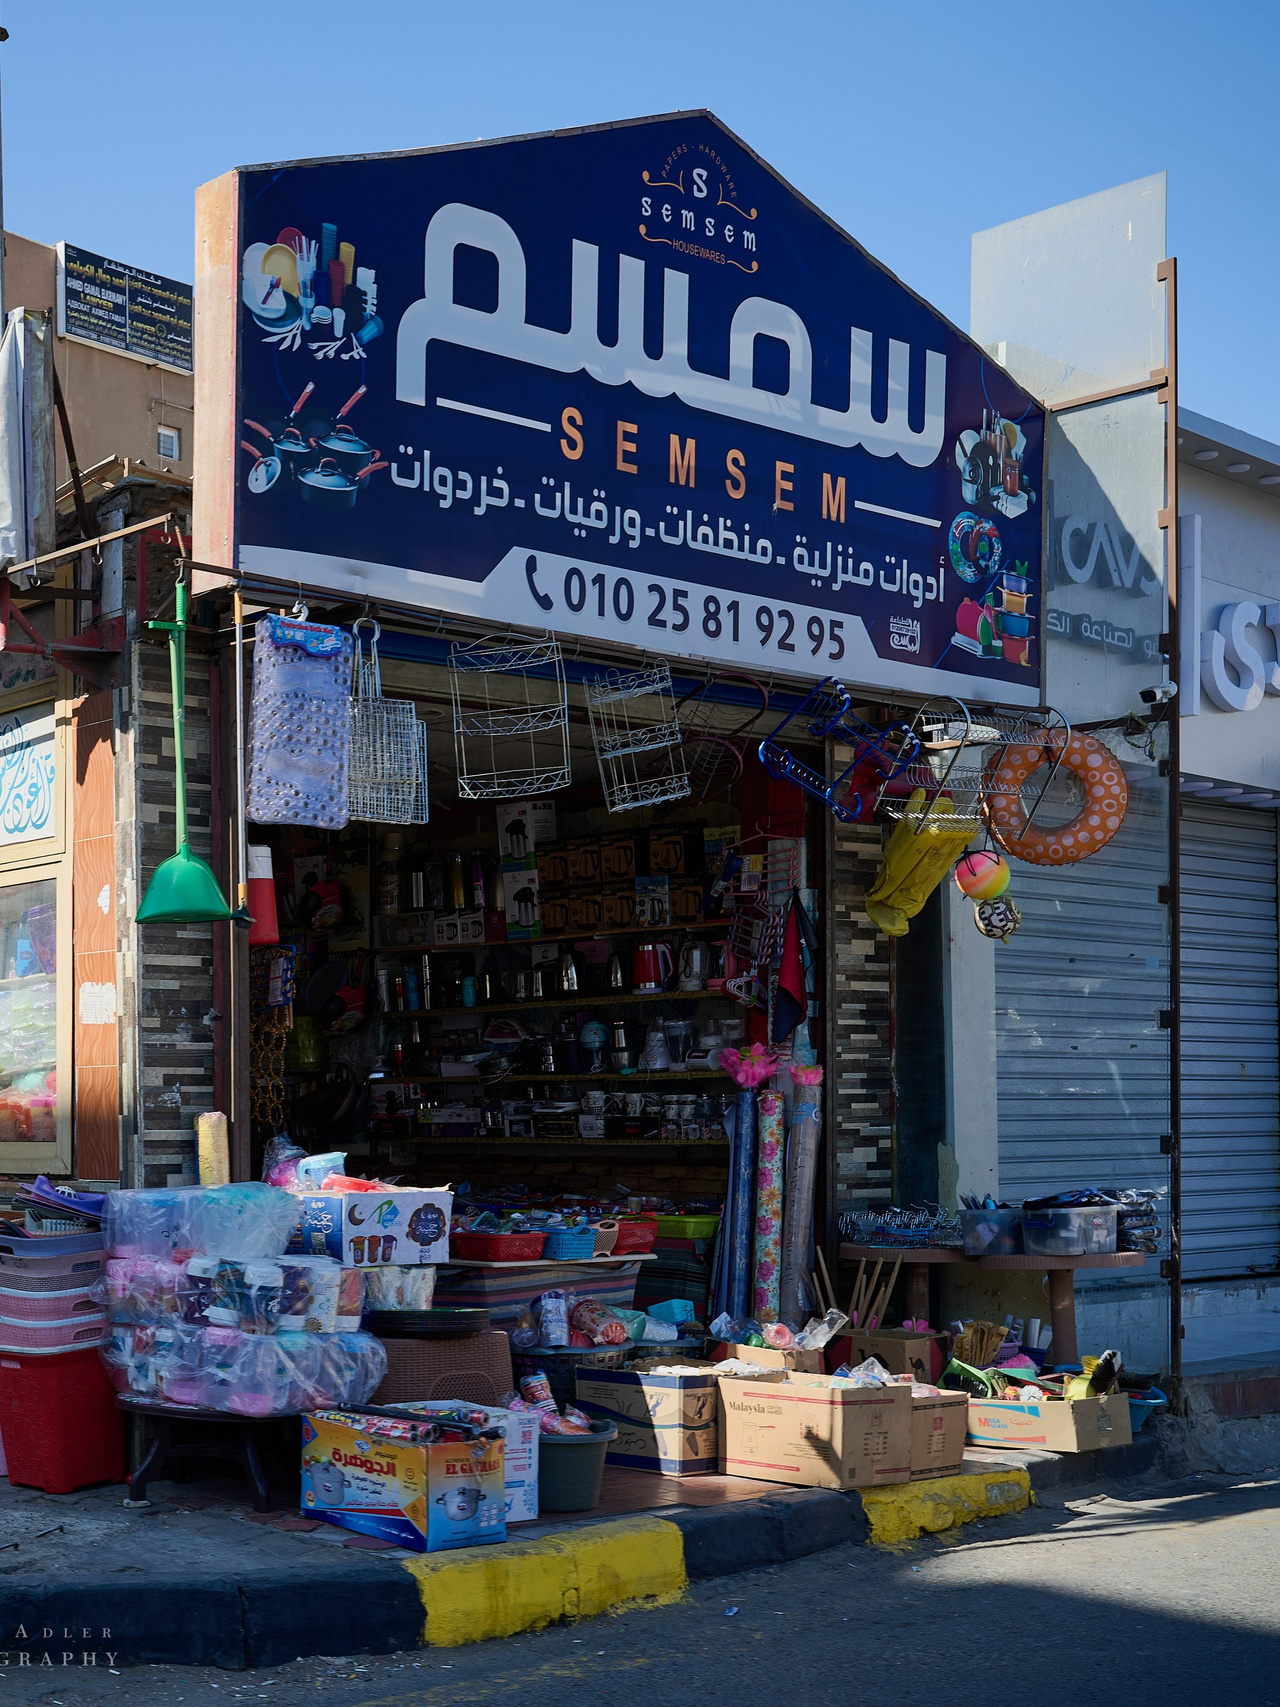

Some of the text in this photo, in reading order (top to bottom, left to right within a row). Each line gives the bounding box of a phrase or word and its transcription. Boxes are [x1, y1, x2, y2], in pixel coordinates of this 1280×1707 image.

[661, 143, 738, 198] PAPERS HARDWARE
[672, 239, 726, 265] HOUSEWARES
[396, 202, 947, 468] سمسم
[560, 406, 846, 524] SEMSEM
[390, 444, 945, 609] أدوات منزلية منظفات ورقيات خردوات
[564, 567, 635, 622] 010
[647, 583, 690, 633] 25
[702, 595, 740, 642] 81
[755, 605, 796, 652] 92
[807, 615, 845, 661] 95
[729, 1401, 766, 1415] Malaysia
[332, 1447, 397, 1477] الجوهرة
